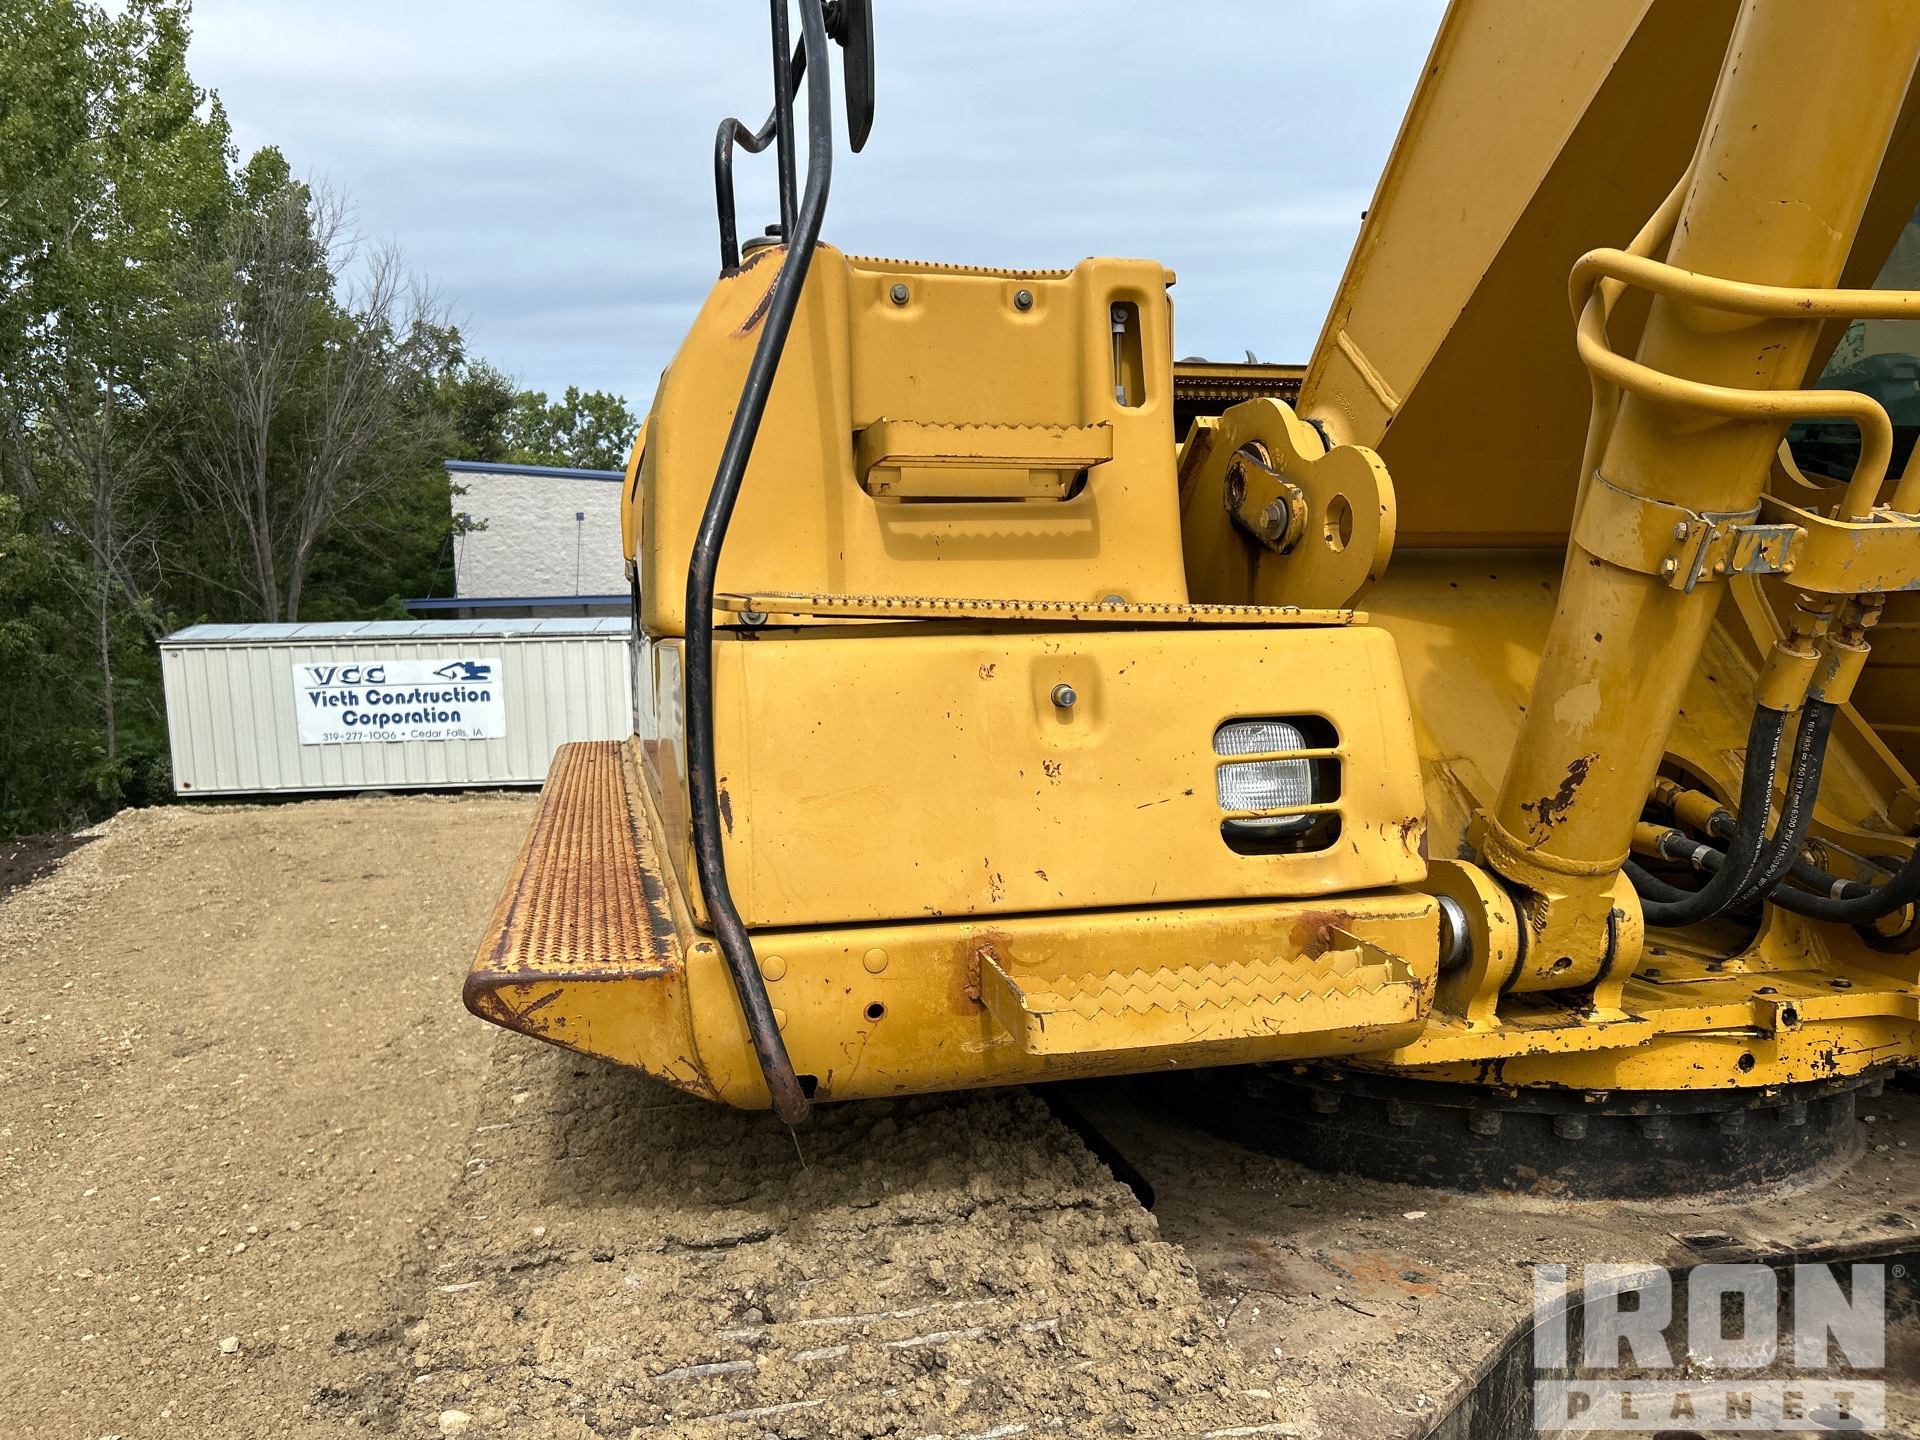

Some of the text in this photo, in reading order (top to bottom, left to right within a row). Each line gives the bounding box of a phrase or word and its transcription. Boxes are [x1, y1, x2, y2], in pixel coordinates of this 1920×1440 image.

[304, 664, 386, 686] VCC
[308, 686, 491, 708] Vieth Construction
[342, 707, 461, 729] Corporation
[323, 728, 483, 741] 319-277-1006 Cedar Falls, IA
[1788, 809, 1799, 828] 6000
